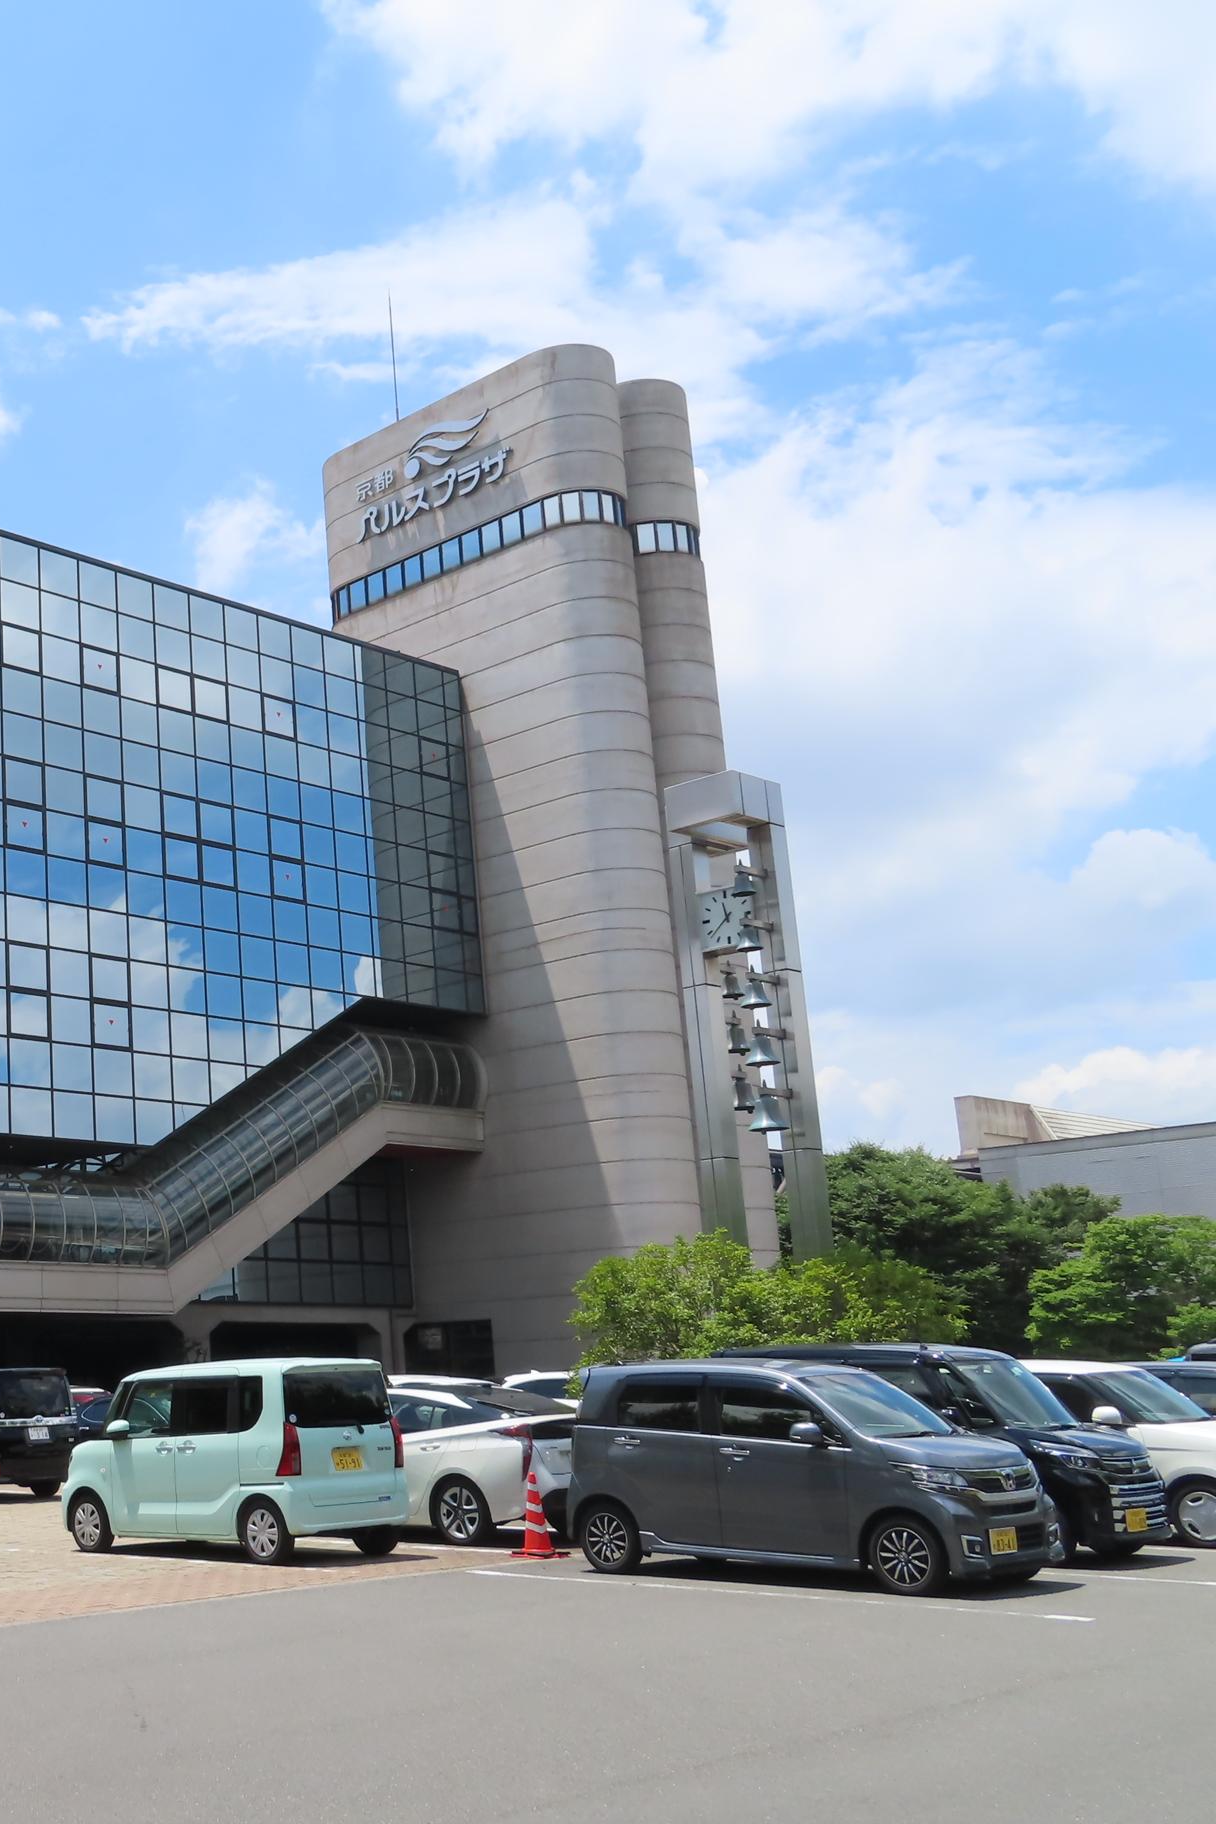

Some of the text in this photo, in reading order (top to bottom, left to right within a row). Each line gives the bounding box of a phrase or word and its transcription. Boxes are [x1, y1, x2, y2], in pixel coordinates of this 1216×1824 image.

[355, 467, 394, 502] 京都
[357, 446, 513, 544] パルスプラザ
